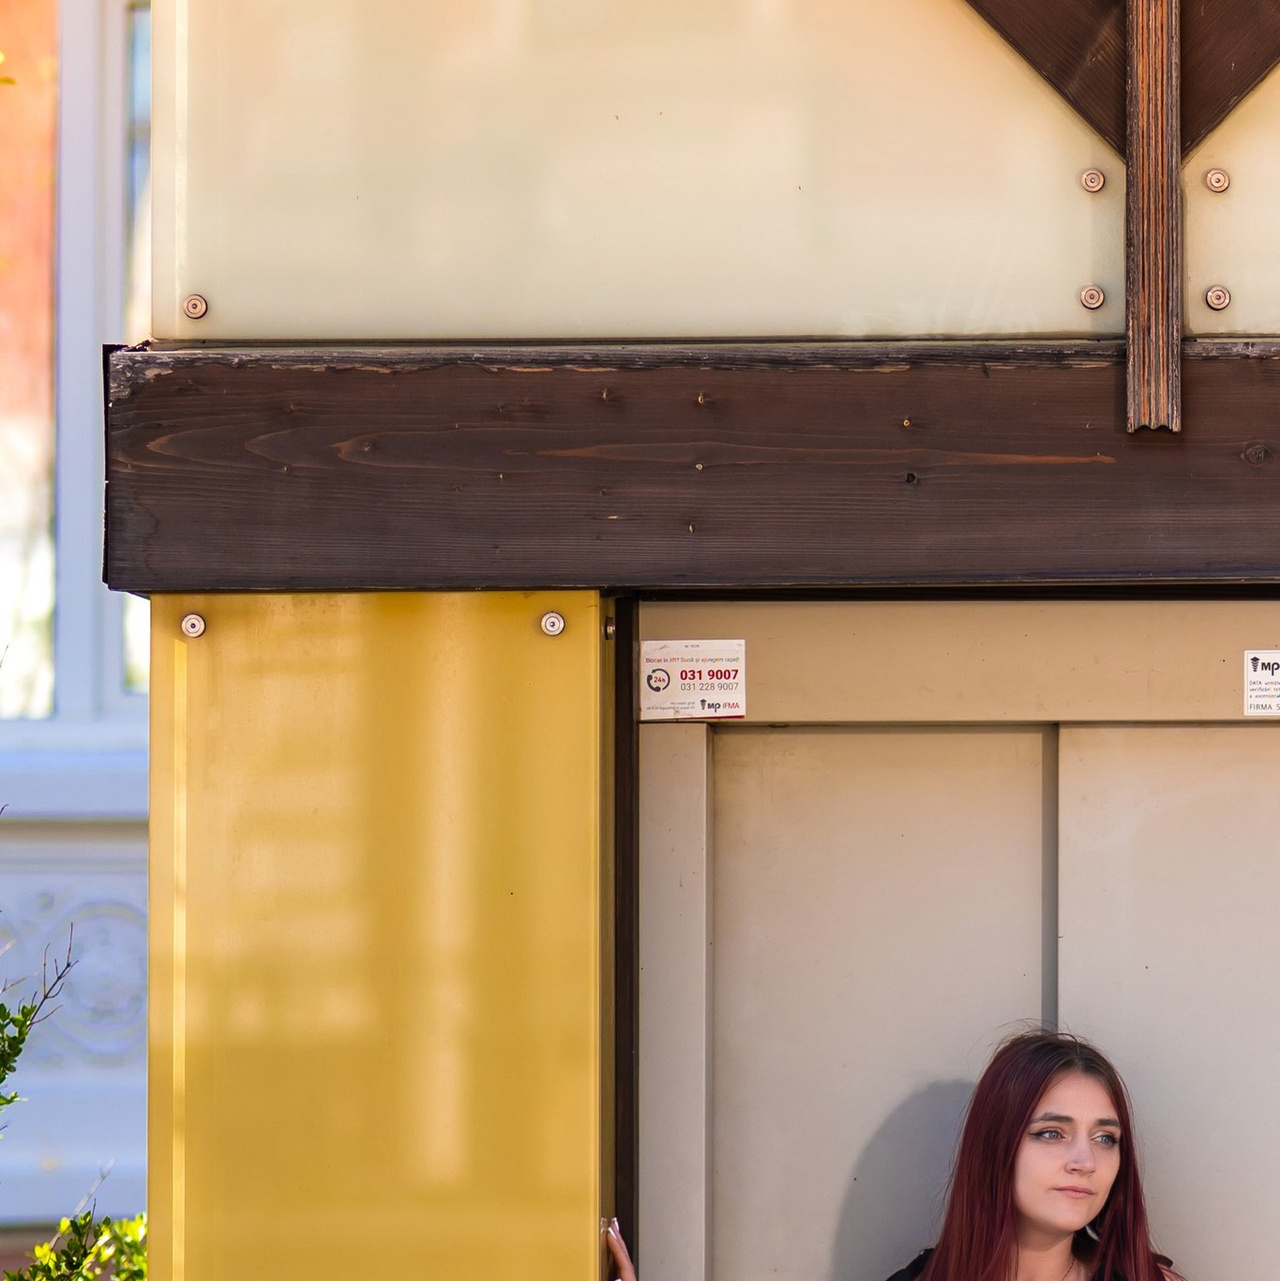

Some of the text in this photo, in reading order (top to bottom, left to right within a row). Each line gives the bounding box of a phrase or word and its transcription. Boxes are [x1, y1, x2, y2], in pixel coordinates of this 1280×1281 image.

[680, 669, 739, 681] 031 9007
[680, 683, 739, 691] 031 228 9007
[1250, 703, 1273, 711] FIRMA
